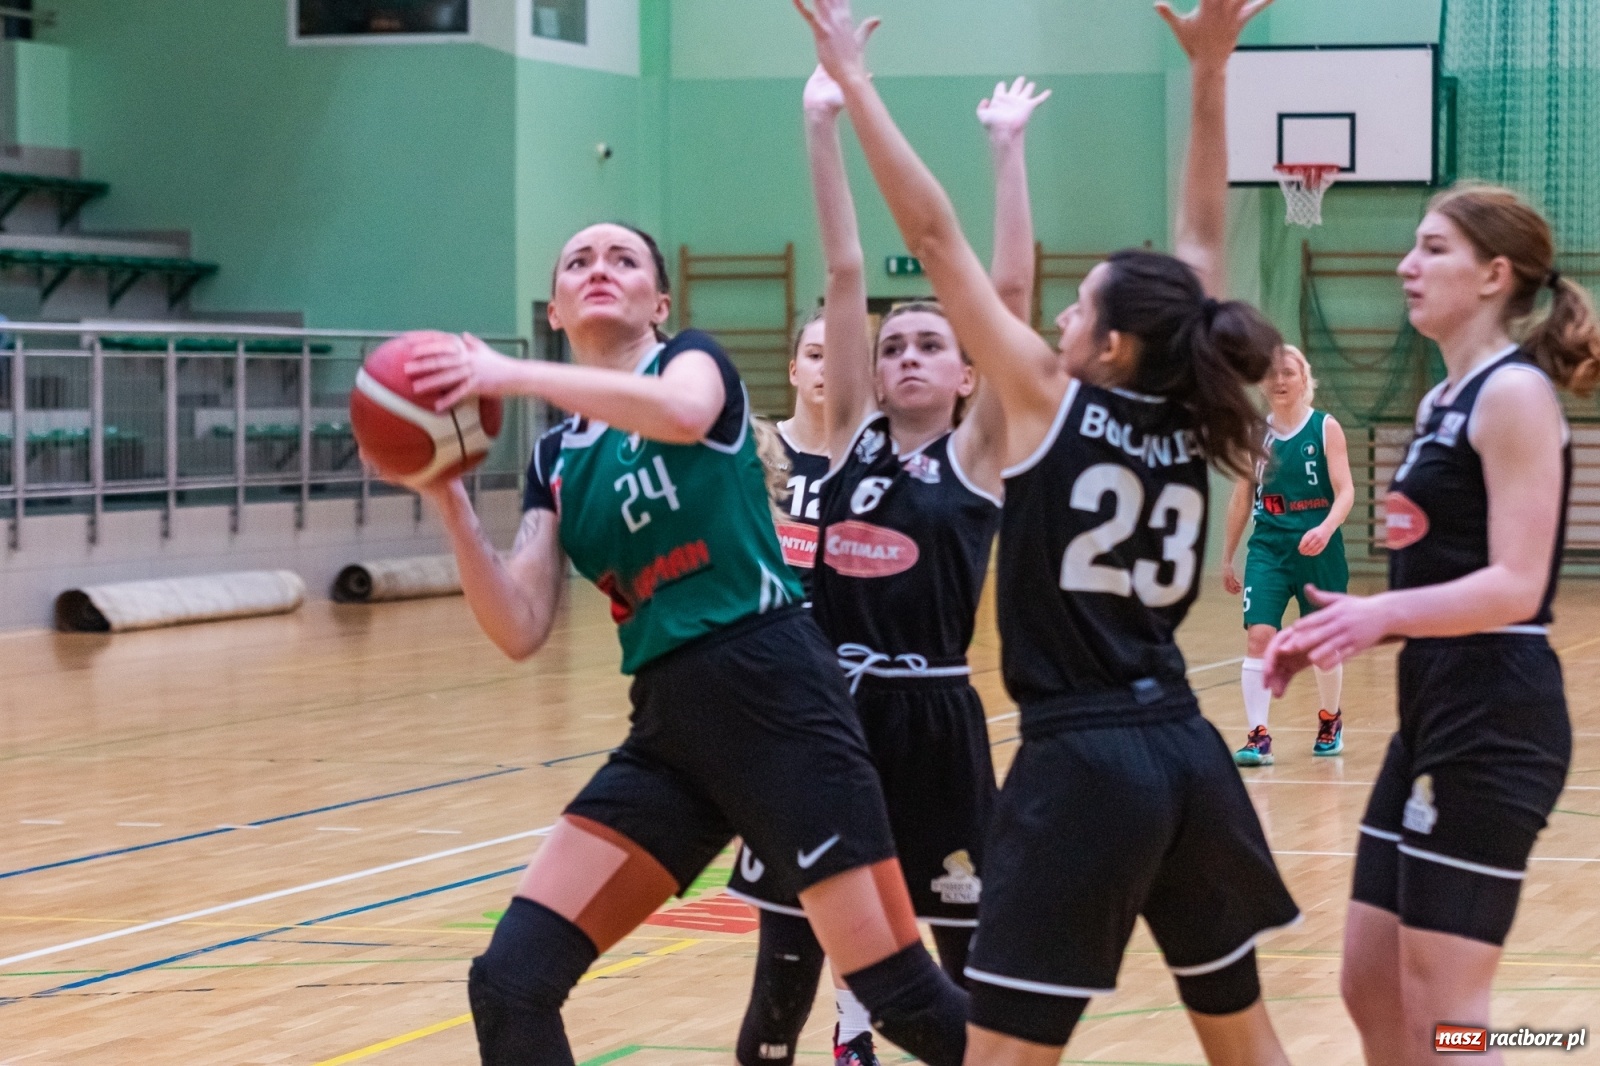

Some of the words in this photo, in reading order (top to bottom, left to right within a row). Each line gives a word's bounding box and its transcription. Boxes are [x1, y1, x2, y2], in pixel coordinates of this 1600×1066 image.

[614, 455, 680, 533] 24
[850, 476, 893, 515] 6
[1305, 461, 1319, 486] 5
[1060, 462, 1204, 608] 23
